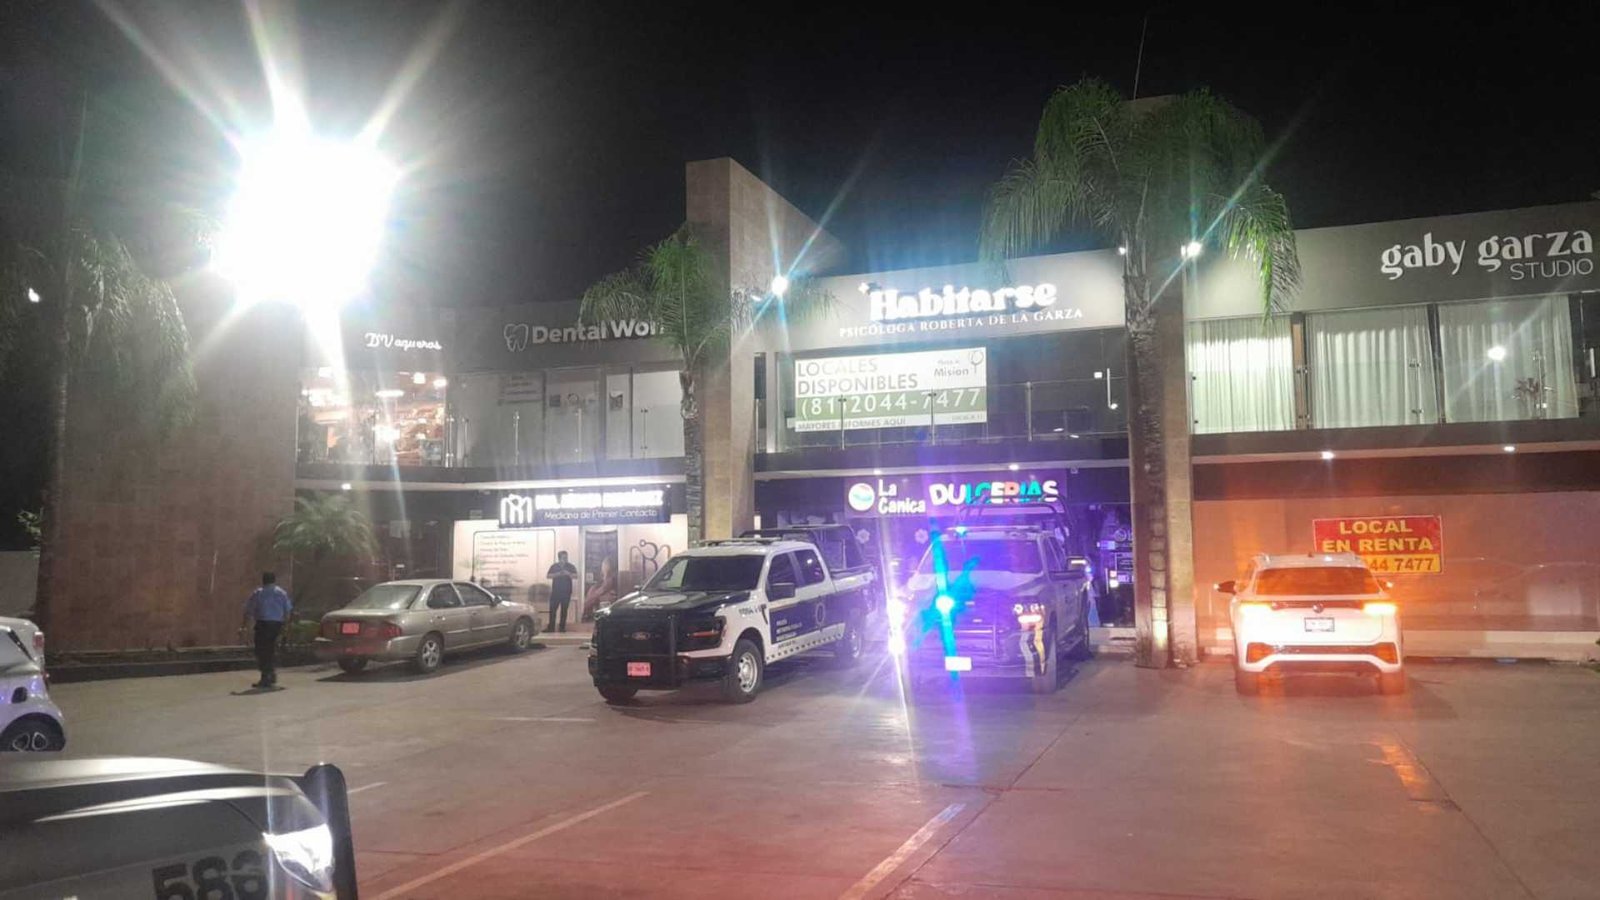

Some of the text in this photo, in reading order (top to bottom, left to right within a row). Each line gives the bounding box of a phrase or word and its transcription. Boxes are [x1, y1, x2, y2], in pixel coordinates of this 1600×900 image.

[1381, 230, 1593, 280] gaby garza
[1510, 258, 1594, 280] STUDIO
[869, 282, 1057, 321] Habitarse
[920, 318, 983, 331] ROBERTA
[989, 315, 1008, 326] DE
[1012, 313, 1029, 323] LA
[1034, 307, 1083, 321] GARZA
[532, 320, 607, 345] Dental
[798, 358, 878, 377] LOCALES
[798, 373, 918, 395] DISPONIBLES
[878, 479, 898, 497] La
[580, 510, 591, 519] de
[592, 509, 618, 519] Primer
[620, 508, 658, 518] Contacto
[878, 497, 926, 515] Canica
[1340, 520, 1413, 535] LOCAL
[1322, 537, 1434, 553] EN RENTA
[1369, 557, 1434, 571] 44 7477
